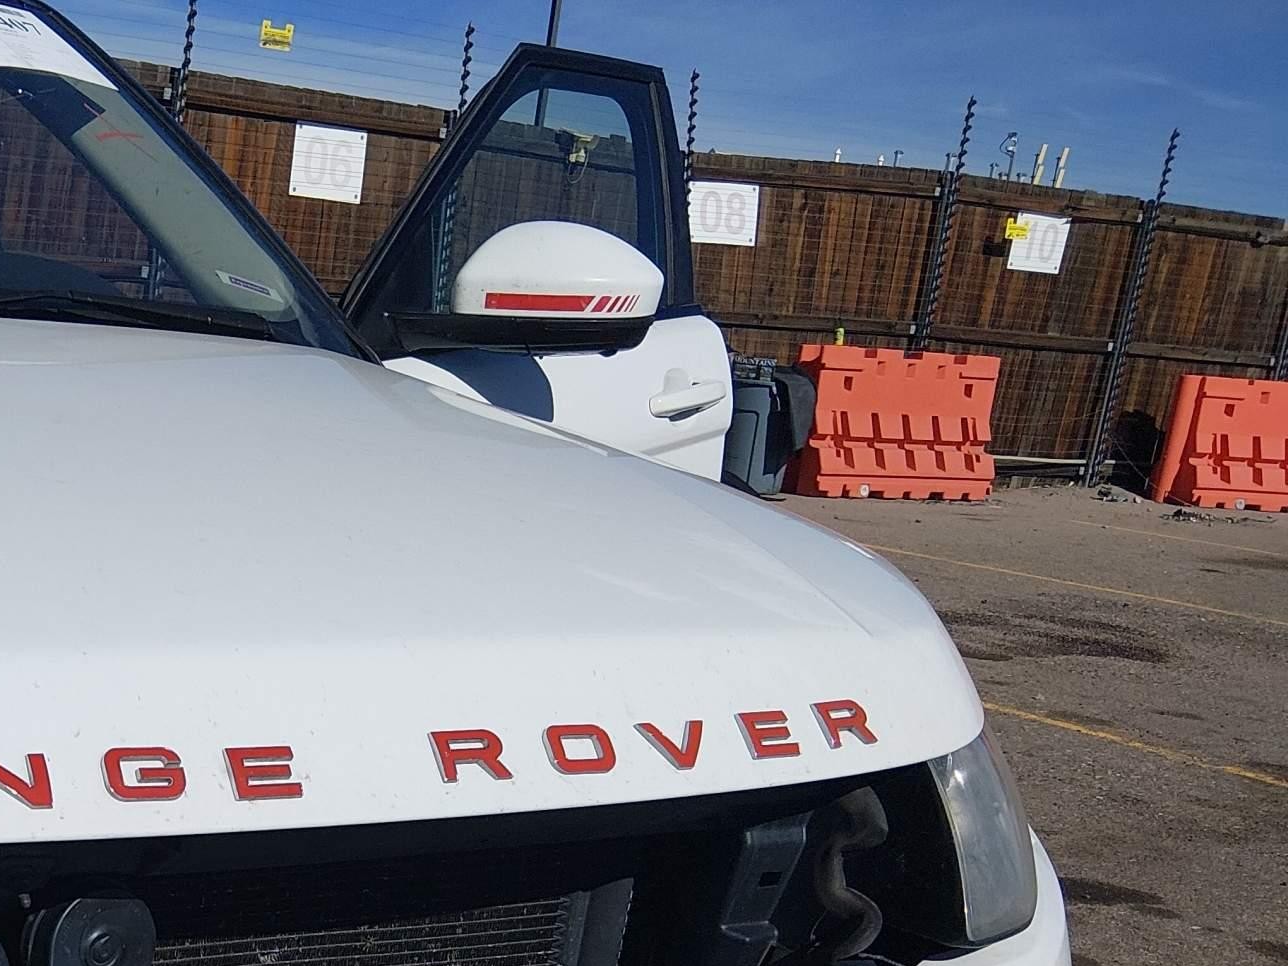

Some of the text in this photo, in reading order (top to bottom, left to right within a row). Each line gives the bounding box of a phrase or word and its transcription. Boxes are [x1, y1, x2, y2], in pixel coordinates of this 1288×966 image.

[304, 136, 354, 188] 06
[699, 190, 746, 235] 08
[1024, 221, 1059, 263] 10
[427, 699, 878, 784] ROVER
